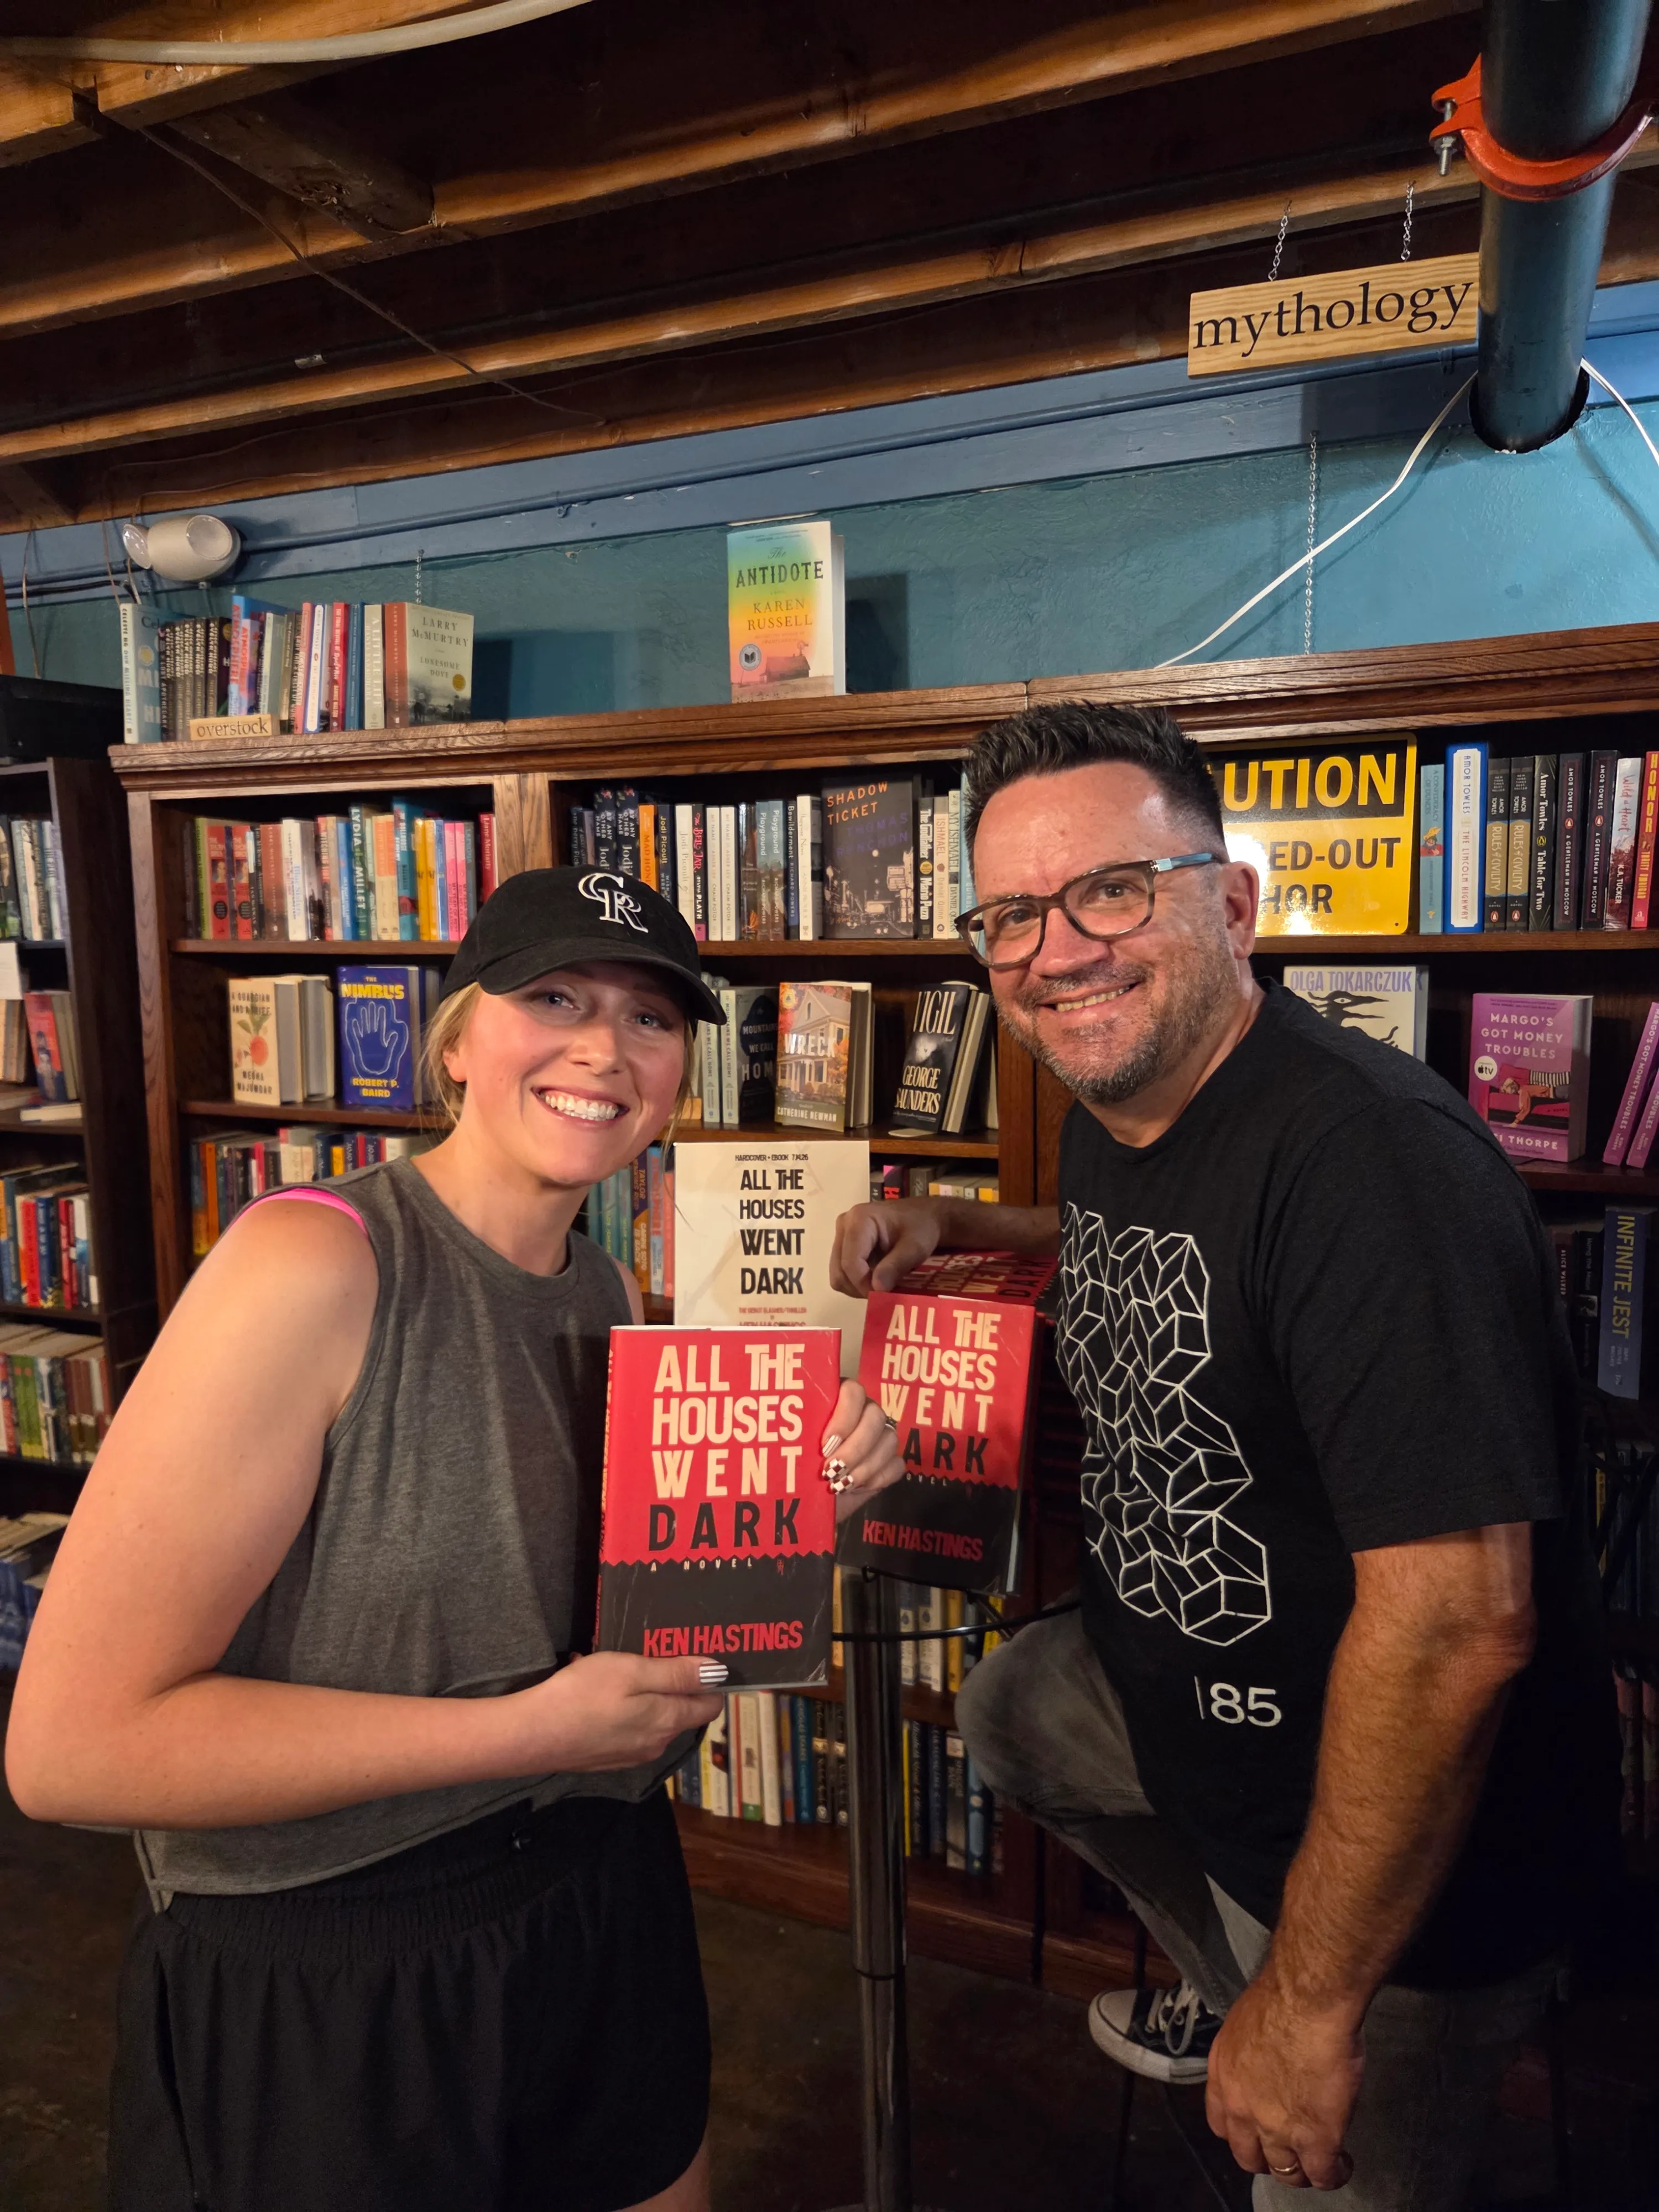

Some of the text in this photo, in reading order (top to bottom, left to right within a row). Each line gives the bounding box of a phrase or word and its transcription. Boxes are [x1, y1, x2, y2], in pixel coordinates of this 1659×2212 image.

[1192, 281, 1474, 357] mythology
[735, 561, 823, 588] ANTIDOTE
[753, 598, 805, 614] KAREN
[411, 627, 468, 646] McMURTRY
[422, 617, 458, 631] LARRY
[748, 614, 812, 630] RUSSELL
[372, 629, 382, 708] LITTLE LIFE
[420, 656, 460, 670] LONESOME
[430, 669, 448, 679] DOVE
[197, 717, 269, 738] overstock
[827, 780, 889, 808] SHADOW
[1223, 753, 1397, 812] UTION
[1645, 753, 1658, 832] HONOR
[827, 802, 878, 826] TICKET
[1538, 773, 1548, 831] Amor Towles
[1618, 775, 1635, 832] Wild Heart
[771, 810, 780, 854] Playground
[847, 812, 908, 837] THOMAS
[920, 808, 933, 859] The Godfather
[936, 818, 945, 857] ISHMAEL
[679, 831, 689, 849] Jodi
[693, 828, 703, 851] BELL
[836, 831, 908, 857] PYNCHON
[948, 812, 959, 871] MY ISHMAEL
[1269, 837, 1401, 871] ED-OUT
[351, 808, 366, 910] LYDIA MILLET
[483, 839, 492, 870] Moriarty
[1490, 826, 1501, 891] RULES CIVILITY
[1511, 825, 1524, 889] RULES CIVILITY
[1460, 831, 1470, 920] THE LINCOLN HIGHWAY
[1535, 850, 1547, 910] Table for Two
[920, 877, 932, 920] Mario Puzo
[950, 886, 958, 910] DANIEL
[1259, 884, 1333, 915] HOR
[1615, 879, 1623, 904] TUCKER
[937, 901, 945, 920] Quinn
[341, 983, 405, 999] NIMBUS
[1290, 971, 1412, 993] OLGA TOKARCZUK
[238, 992, 270, 1003] GUARDIAN
[913, 990, 957, 1035] VIGIL
[1490, 1013, 1554, 1027] MARGO'S
[749, 1044, 761, 1053] WE
[784, 1033, 837, 1059] WRECK
[1481, 1027, 1563, 1044] GOT MONEY
[1485, 1043, 1556, 1060] TROUBLES
[352, 1078, 388, 1087] ROBERT
[902, 1065, 941, 1089] GEORGE
[1619, 1045, 1651, 1130] GOT MONEY TROUBLES
[362, 1088, 390, 1098] BAIRD
[777, 1106, 837, 1122] CATHERINE NEWMAN
[1508, 1135, 1558, 1150] THORPE
[740, 1169, 804, 1191] ALL THE
[739, 1199, 805, 1219] HOUSES
[740, 1228, 805, 1256] WENT
[1613, 1215, 1635, 1293] INFINITE
[740, 1267, 804, 1295] DARK
[961, 1256, 1018, 1293] WENT
[998, 1259, 1053, 1298] DARK
[886, 1304, 1001, 1350] ALL THE
[1611, 1296, 1631, 1340] JEST
[654, 1343, 805, 1392] ALL THE
[881, 1342, 998, 1391] HOUSES
[651, 1395, 804, 1446] HOUSES
[880, 1383, 994, 1433] WENT
[902, 1427, 990, 1476] ARK
[651, 1445, 803, 1499] WENT
[648, 1498, 801, 1551] DARK
[863, 1519, 983, 1562] KEN HASTINGS
[650, 1557, 753, 1572] A NOVEL
[643, 1621, 804, 1658] KEN HASTINGS
